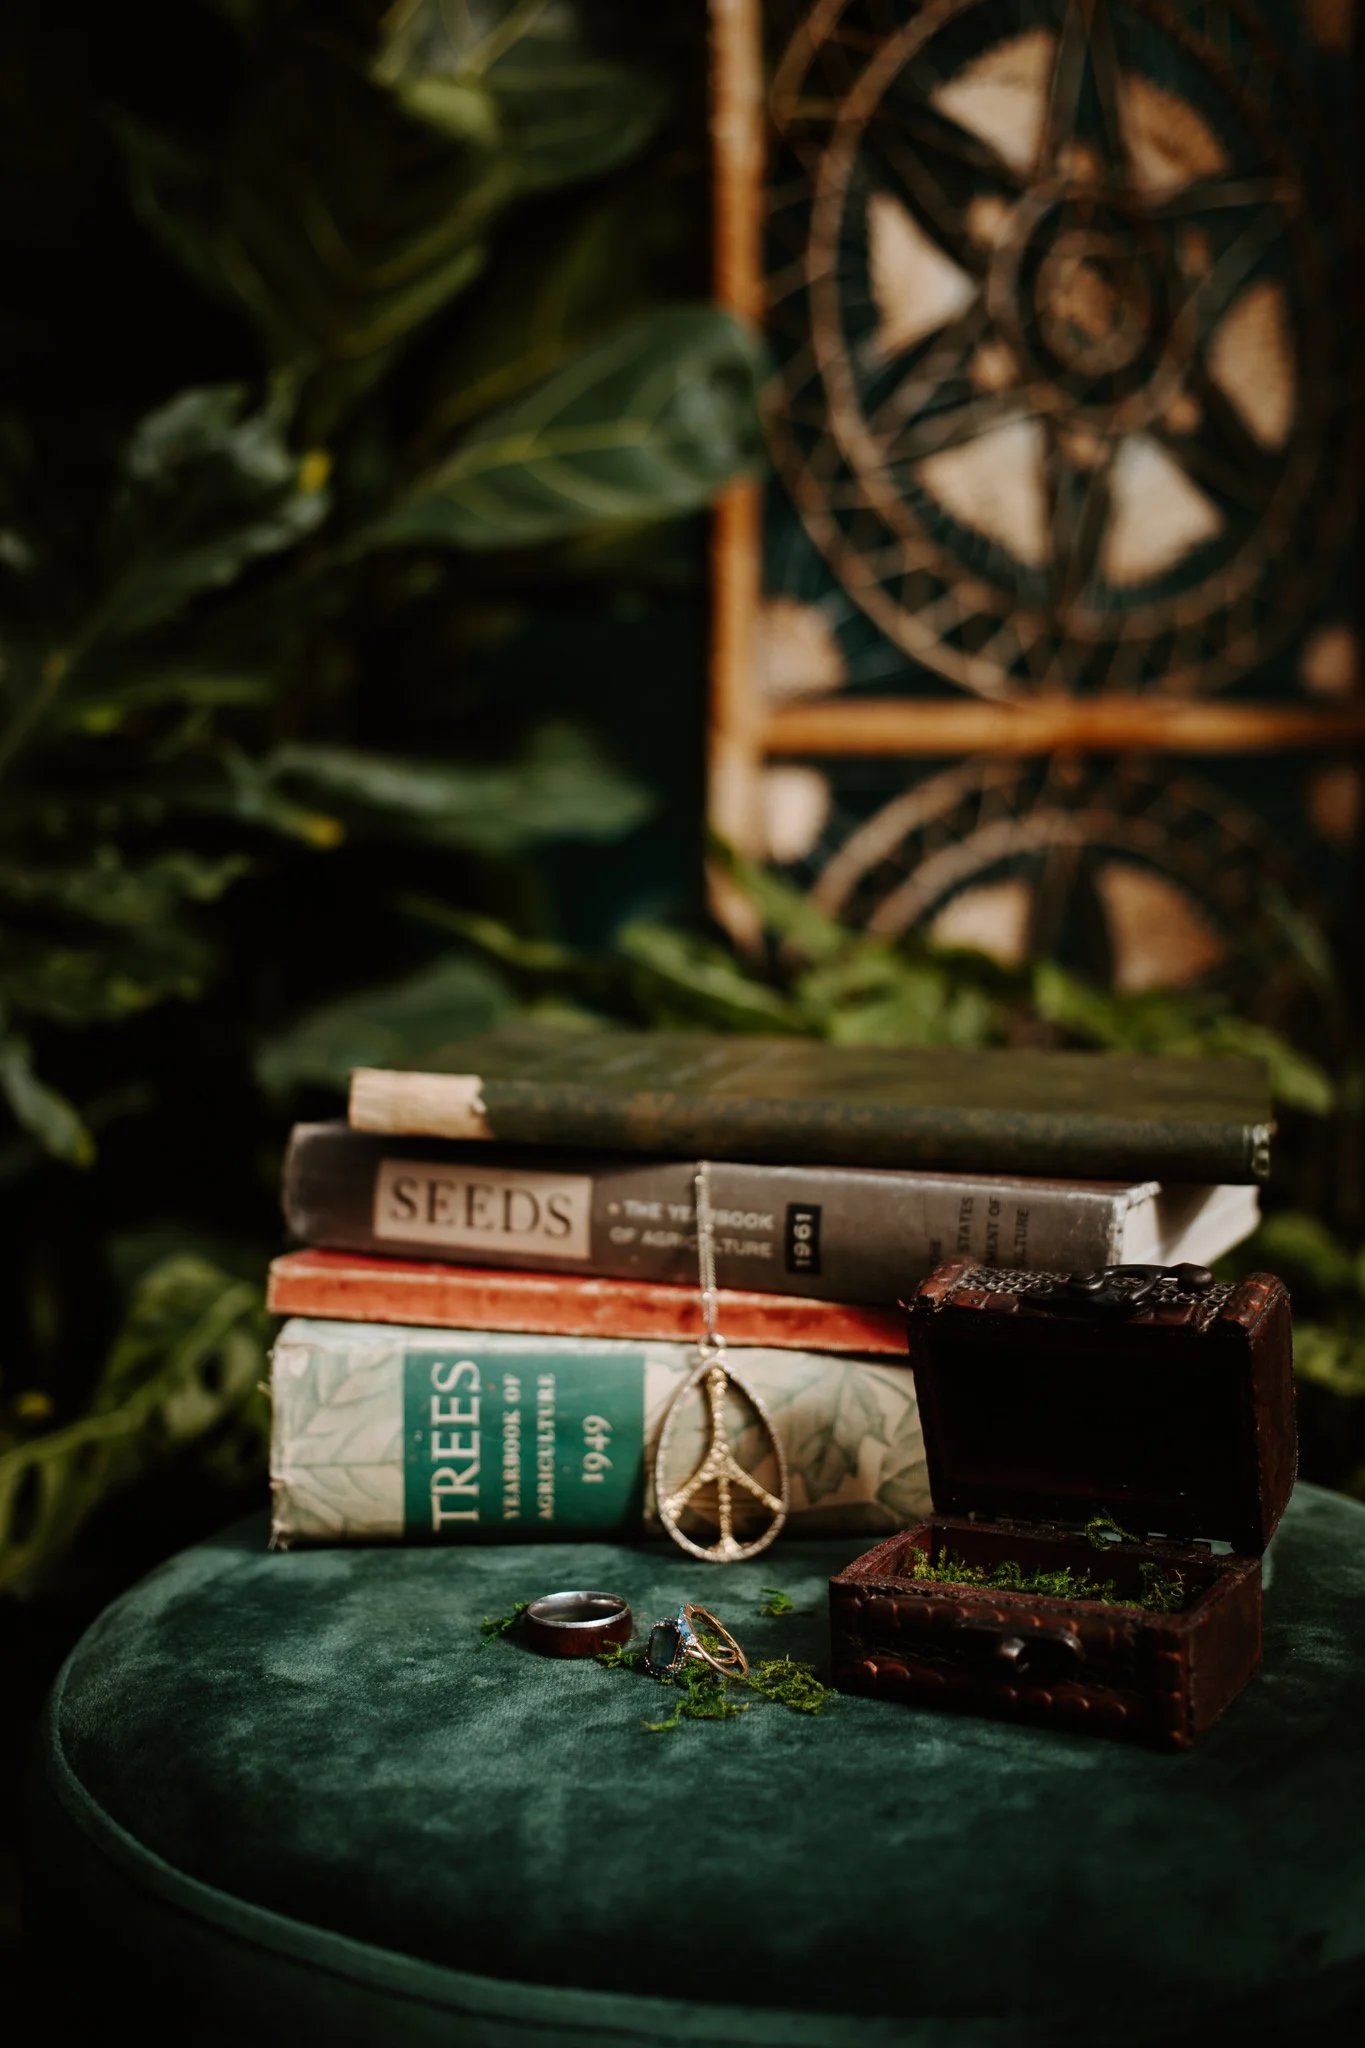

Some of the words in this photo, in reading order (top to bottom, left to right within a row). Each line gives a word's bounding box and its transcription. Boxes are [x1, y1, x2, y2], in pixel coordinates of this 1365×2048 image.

[388, 1175, 573, 1240] SEEDS
[623, 1199, 662, 1221] THE
[668, 1204, 774, 1231] YEBOOK
[957, 1196, 974, 1252] STATES
[988, 1196, 1001, 1218] OF
[608, 1226, 638, 1245] OF
[640, 1229, 774, 1259] AGRTURE
[793, 1213, 813, 1266] 1961
[985, 1221, 999, 1268] MENT
[1014, 1207, 1030, 1268] ULTURE
[503, 1373, 521, 1404] OF
[430, 1360, 482, 1532] TREES
[503, 1408, 521, 1521] YEARBOOK
[537, 1372, 556, 1521] AGRICULTURE
[582, 1414, 614, 1484] 1949
